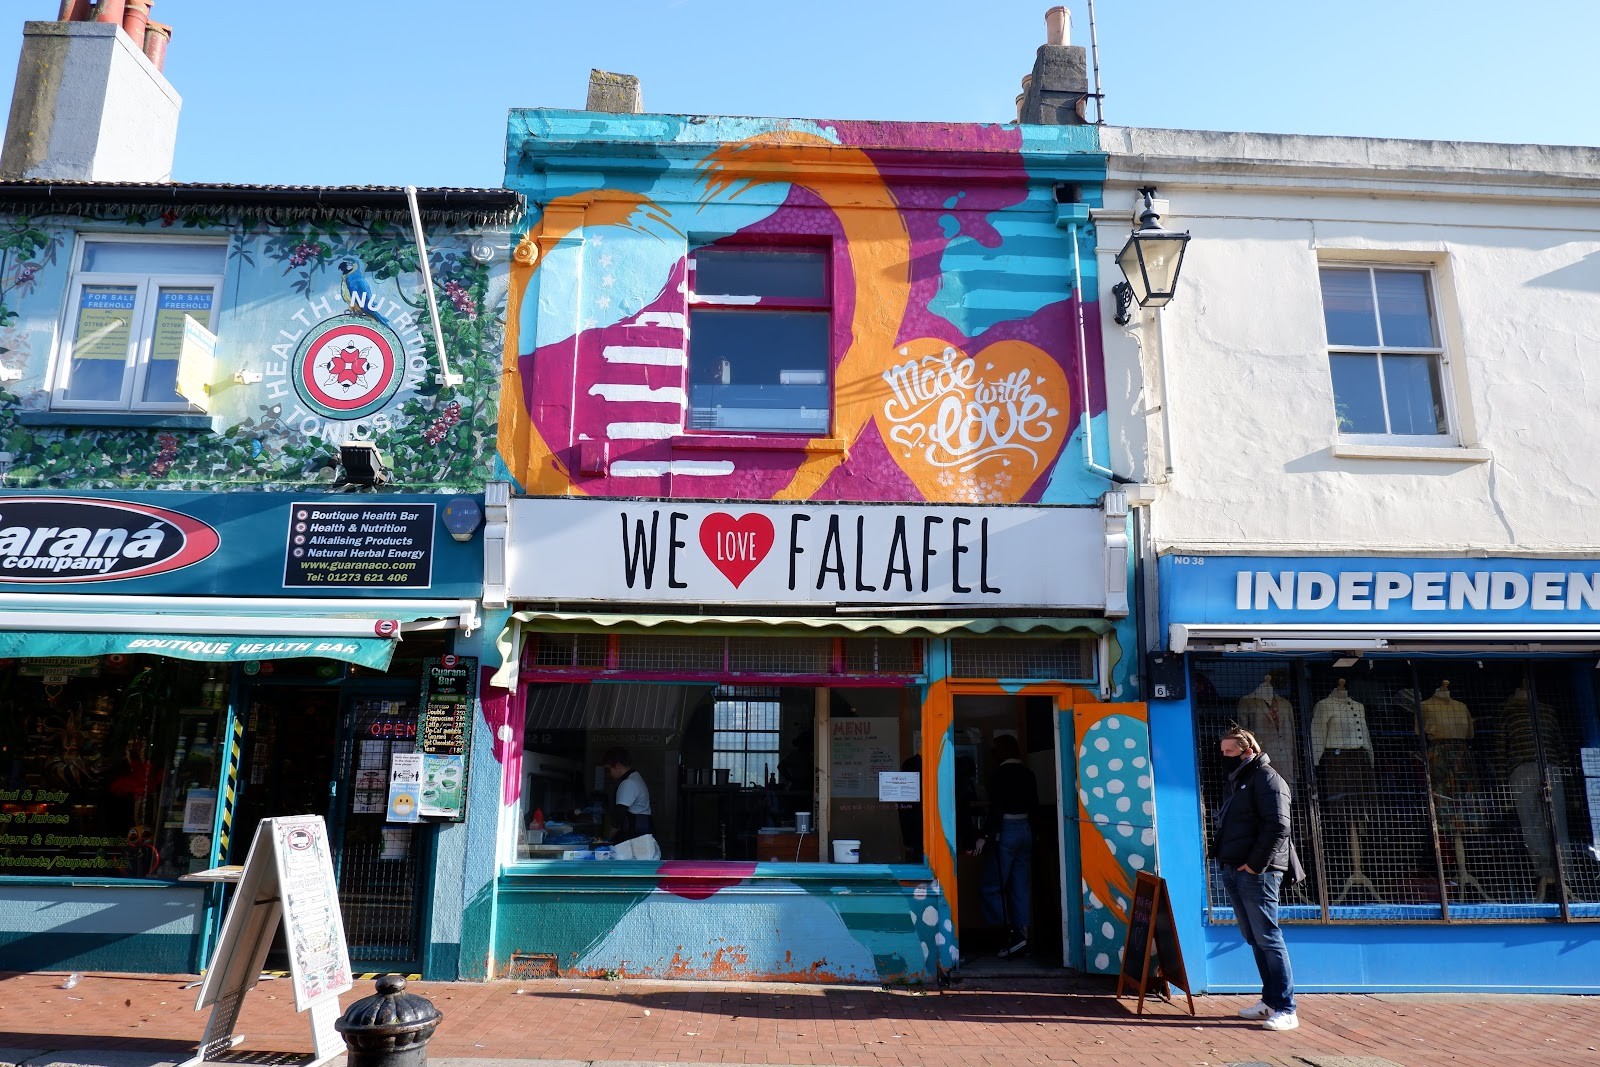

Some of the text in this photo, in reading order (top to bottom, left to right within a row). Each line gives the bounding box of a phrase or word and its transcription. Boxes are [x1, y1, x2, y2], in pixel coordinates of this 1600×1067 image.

[350, 291, 428, 391] NUTRITION
[266, 296, 333, 400] HEALTH
[882, 347, 983, 411] Made
[975, 368, 1031, 404] with
[286, 405, 391, 442] TONICS
[928, 394, 1052, 456] love
[311, 511, 419, 522] Boutique Health Bar
[310, 524, 407, 533] Health & Nutrition
[309, 536, 413, 546] Alkalising Products
[307, 549, 425, 559] Natural Herbal Energy
[620, 510, 1002, 594] WE LOVE FALAFEL
[2, 556, 119, 573] company
[300, 561, 416, 571] www.guaranaco.com
[1174, 557, 1204, 565] NO 38
[307, 573, 408, 582] Tel: 01273 621 406
[1236, 571, 1600, 611] INDEPENDEN
[127, 639, 358, 654] BOUTIQUE HEALTH BAR
[438, 677, 455, 685] Bar
[1156, 687, 1164, 696] 6
[371, 724, 416, 736] OPEN
[833, 721, 871, 736] MENU
[35, 790, 69, 803] Body
[28, 812, 70, 823] Juices
[31, 834, 42, 845] &
[45, 834, 128, 847] Supplements
